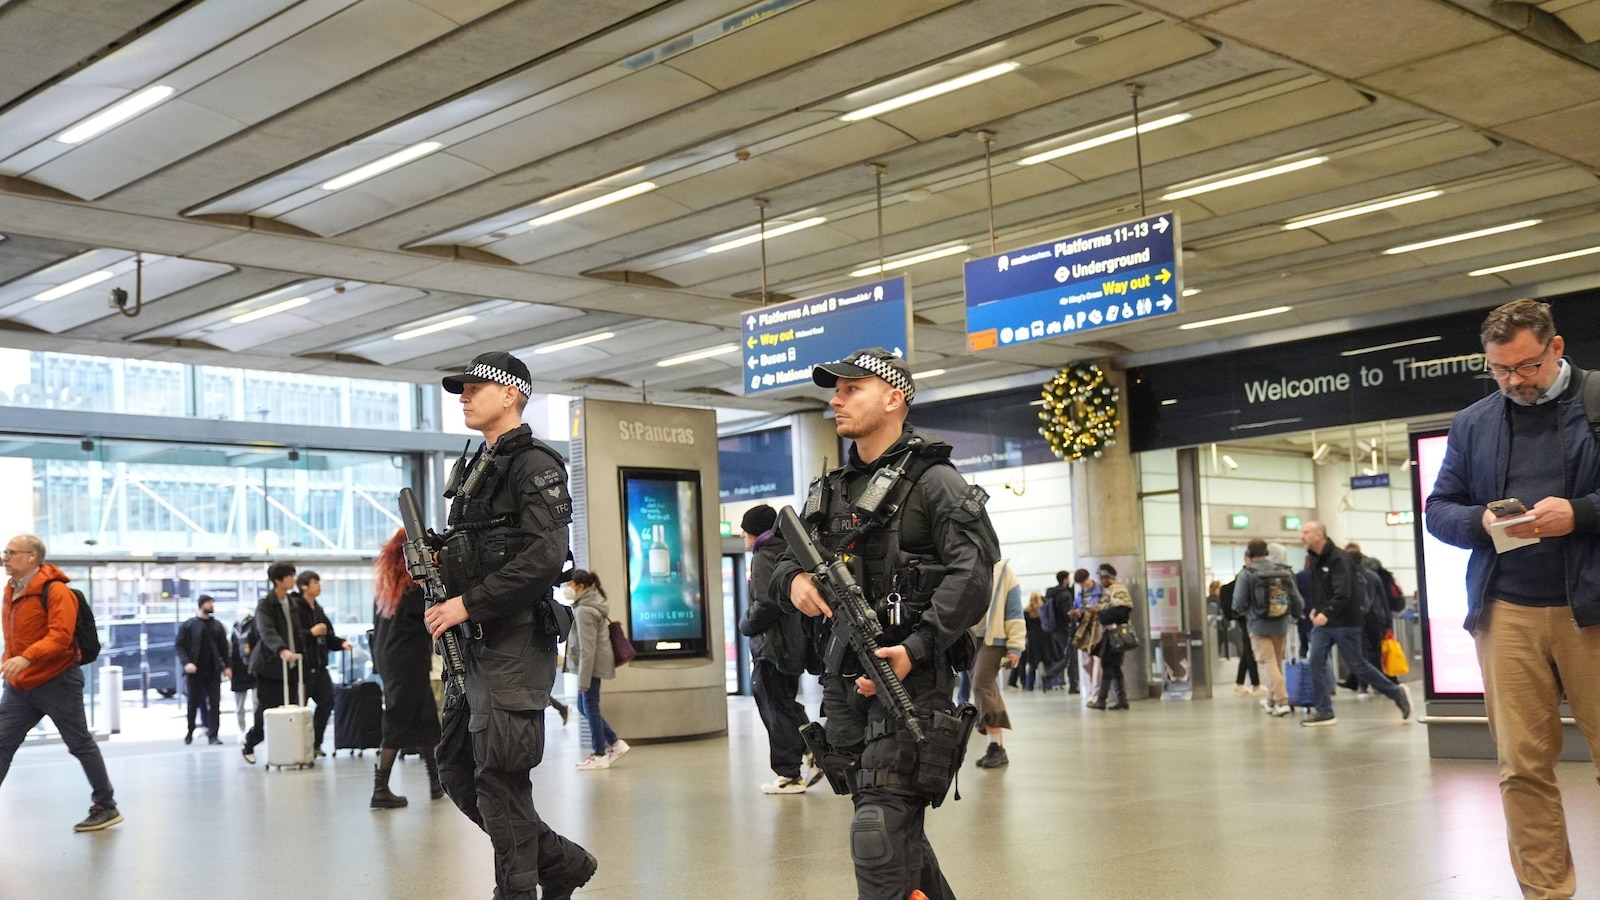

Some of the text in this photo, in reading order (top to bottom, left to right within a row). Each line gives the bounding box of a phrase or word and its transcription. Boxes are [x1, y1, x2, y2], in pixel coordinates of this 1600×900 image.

[1054, 233, 1112, 258] Platforms
[1114, 222, 1150, 244] 11-13
[1072, 248, 1151, 279] Underground
[1102, 280, 1128, 297] Way
[1130, 274, 1151, 290] out
[758, 308, 801, 327] Platforms
[802, 304, 810, 317] A
[810, 302, 828, 315] and
[828, 298, 837, 311] B
[760, 332, 778, 346] Way
[780, 328, 794, 342] out
[760, 352, 787, 367] Buses
[776, 366, 812, 384] National
[1244, 356, 1485, 404] Welcome to Thame
[544, 472, 558, 480] POLICE
[555, 503, 569, 514] TFC
[640, 610, 694, 620] JOHN LEWIS
